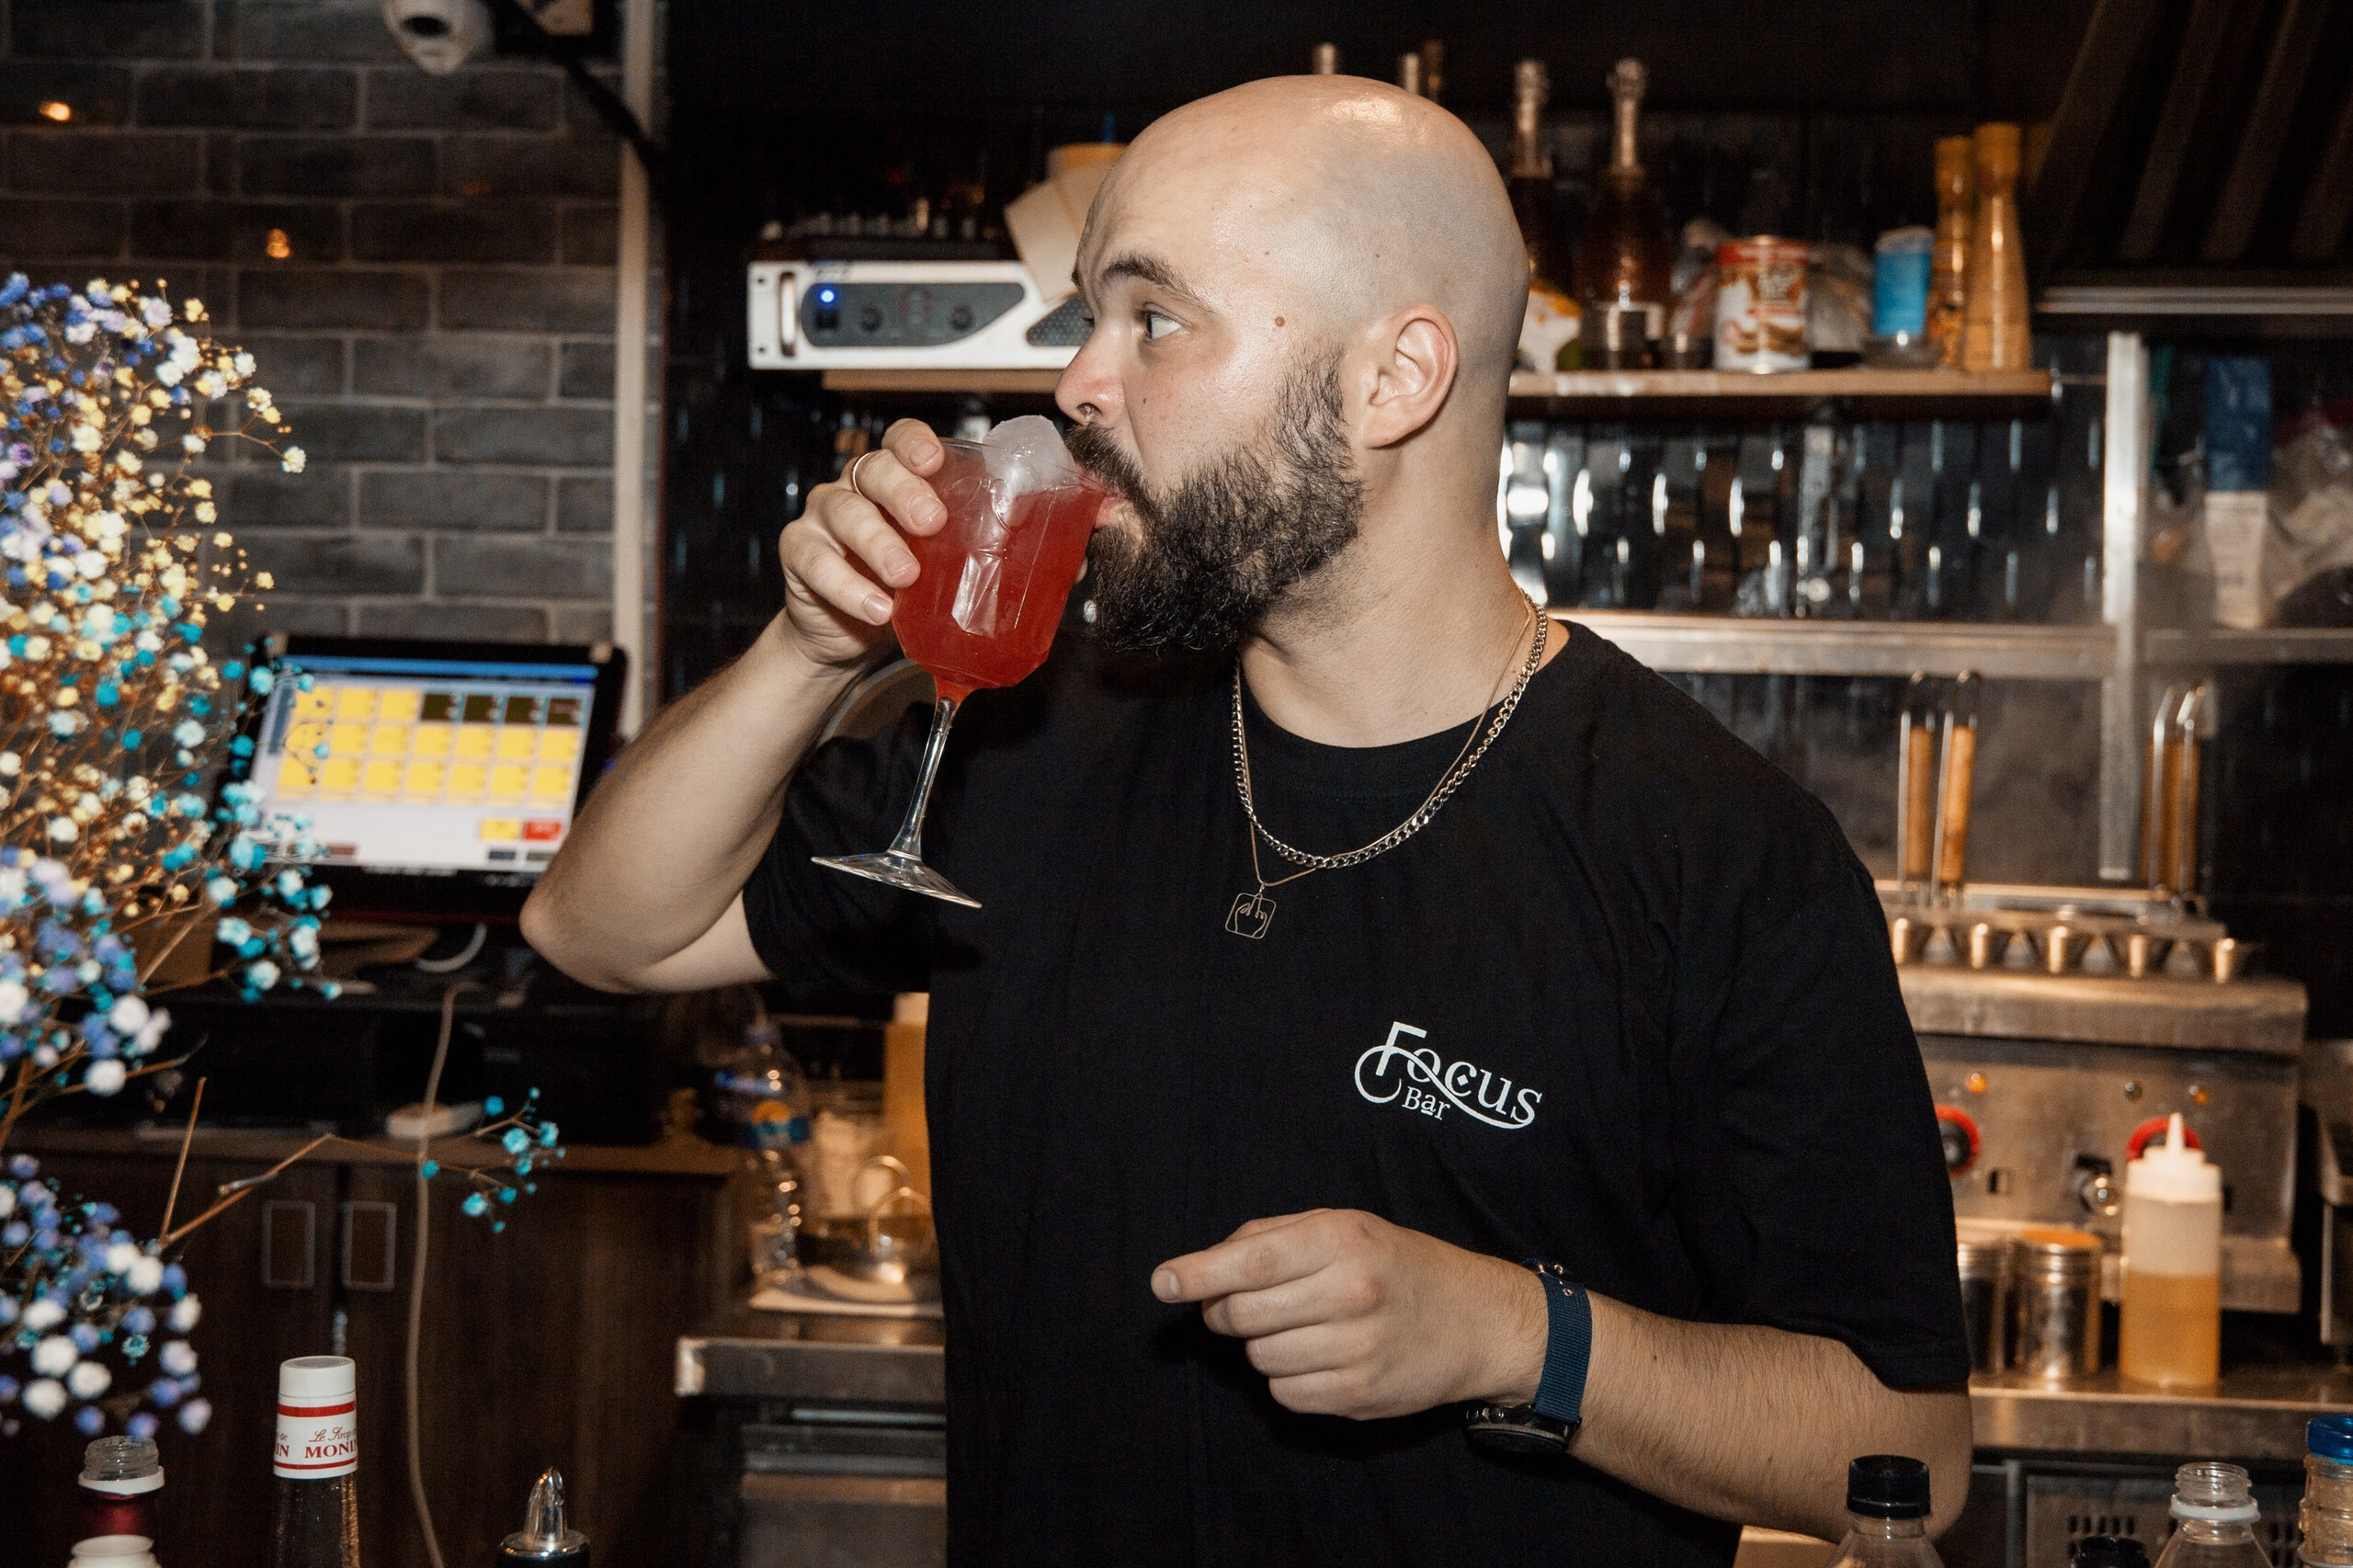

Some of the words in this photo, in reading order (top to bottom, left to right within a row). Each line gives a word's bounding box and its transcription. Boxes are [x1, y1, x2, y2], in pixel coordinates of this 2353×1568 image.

[1354, 1021, 1543, 1130] Focus
[1401, 1085, 1450, 1120] Bar
[308, 1428, 327, 1442] Le
[327, 1426, 352, 1441] Sirop
